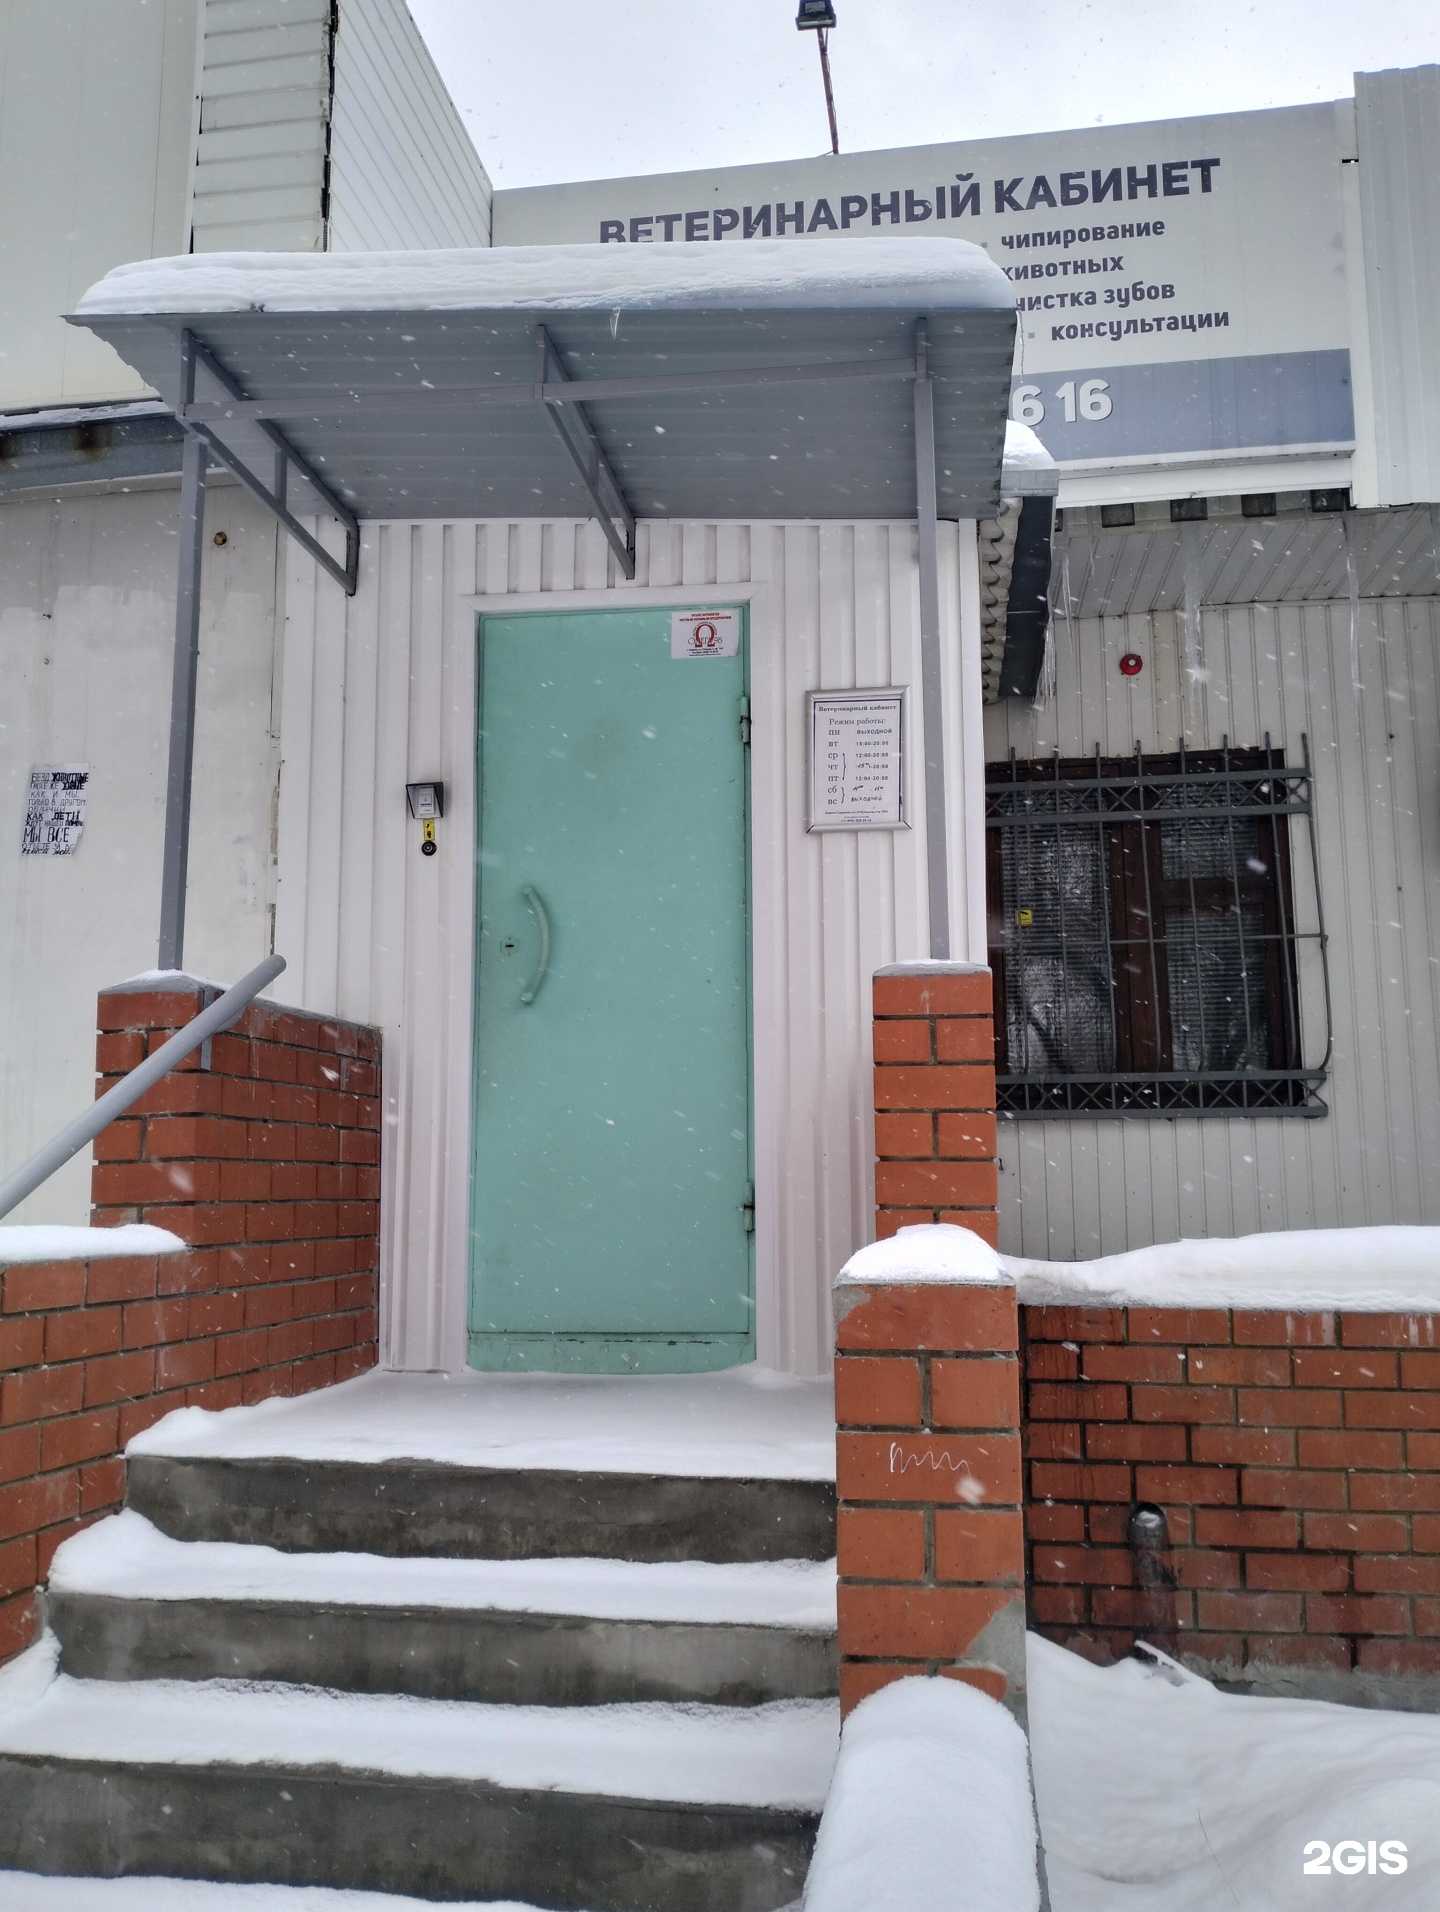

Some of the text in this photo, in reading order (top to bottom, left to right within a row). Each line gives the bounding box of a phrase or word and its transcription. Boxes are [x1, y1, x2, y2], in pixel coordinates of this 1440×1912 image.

[600, 157, 1221, 243] ВЕТЕРИНАРНЫЙ КАБИНЕТ
[1001, 220, 1166, 249] чипирование
[1103, 280, 1175, 308] зубов
[1051, 311, 1230, 341] консультации
[1055, 379, 1113, 423] 16
[829, 718, 855, 726] Режим
[51, 811, 80, 821] ДЕТИ
[23, 826, 70, 843] МЫ ВСЕ
